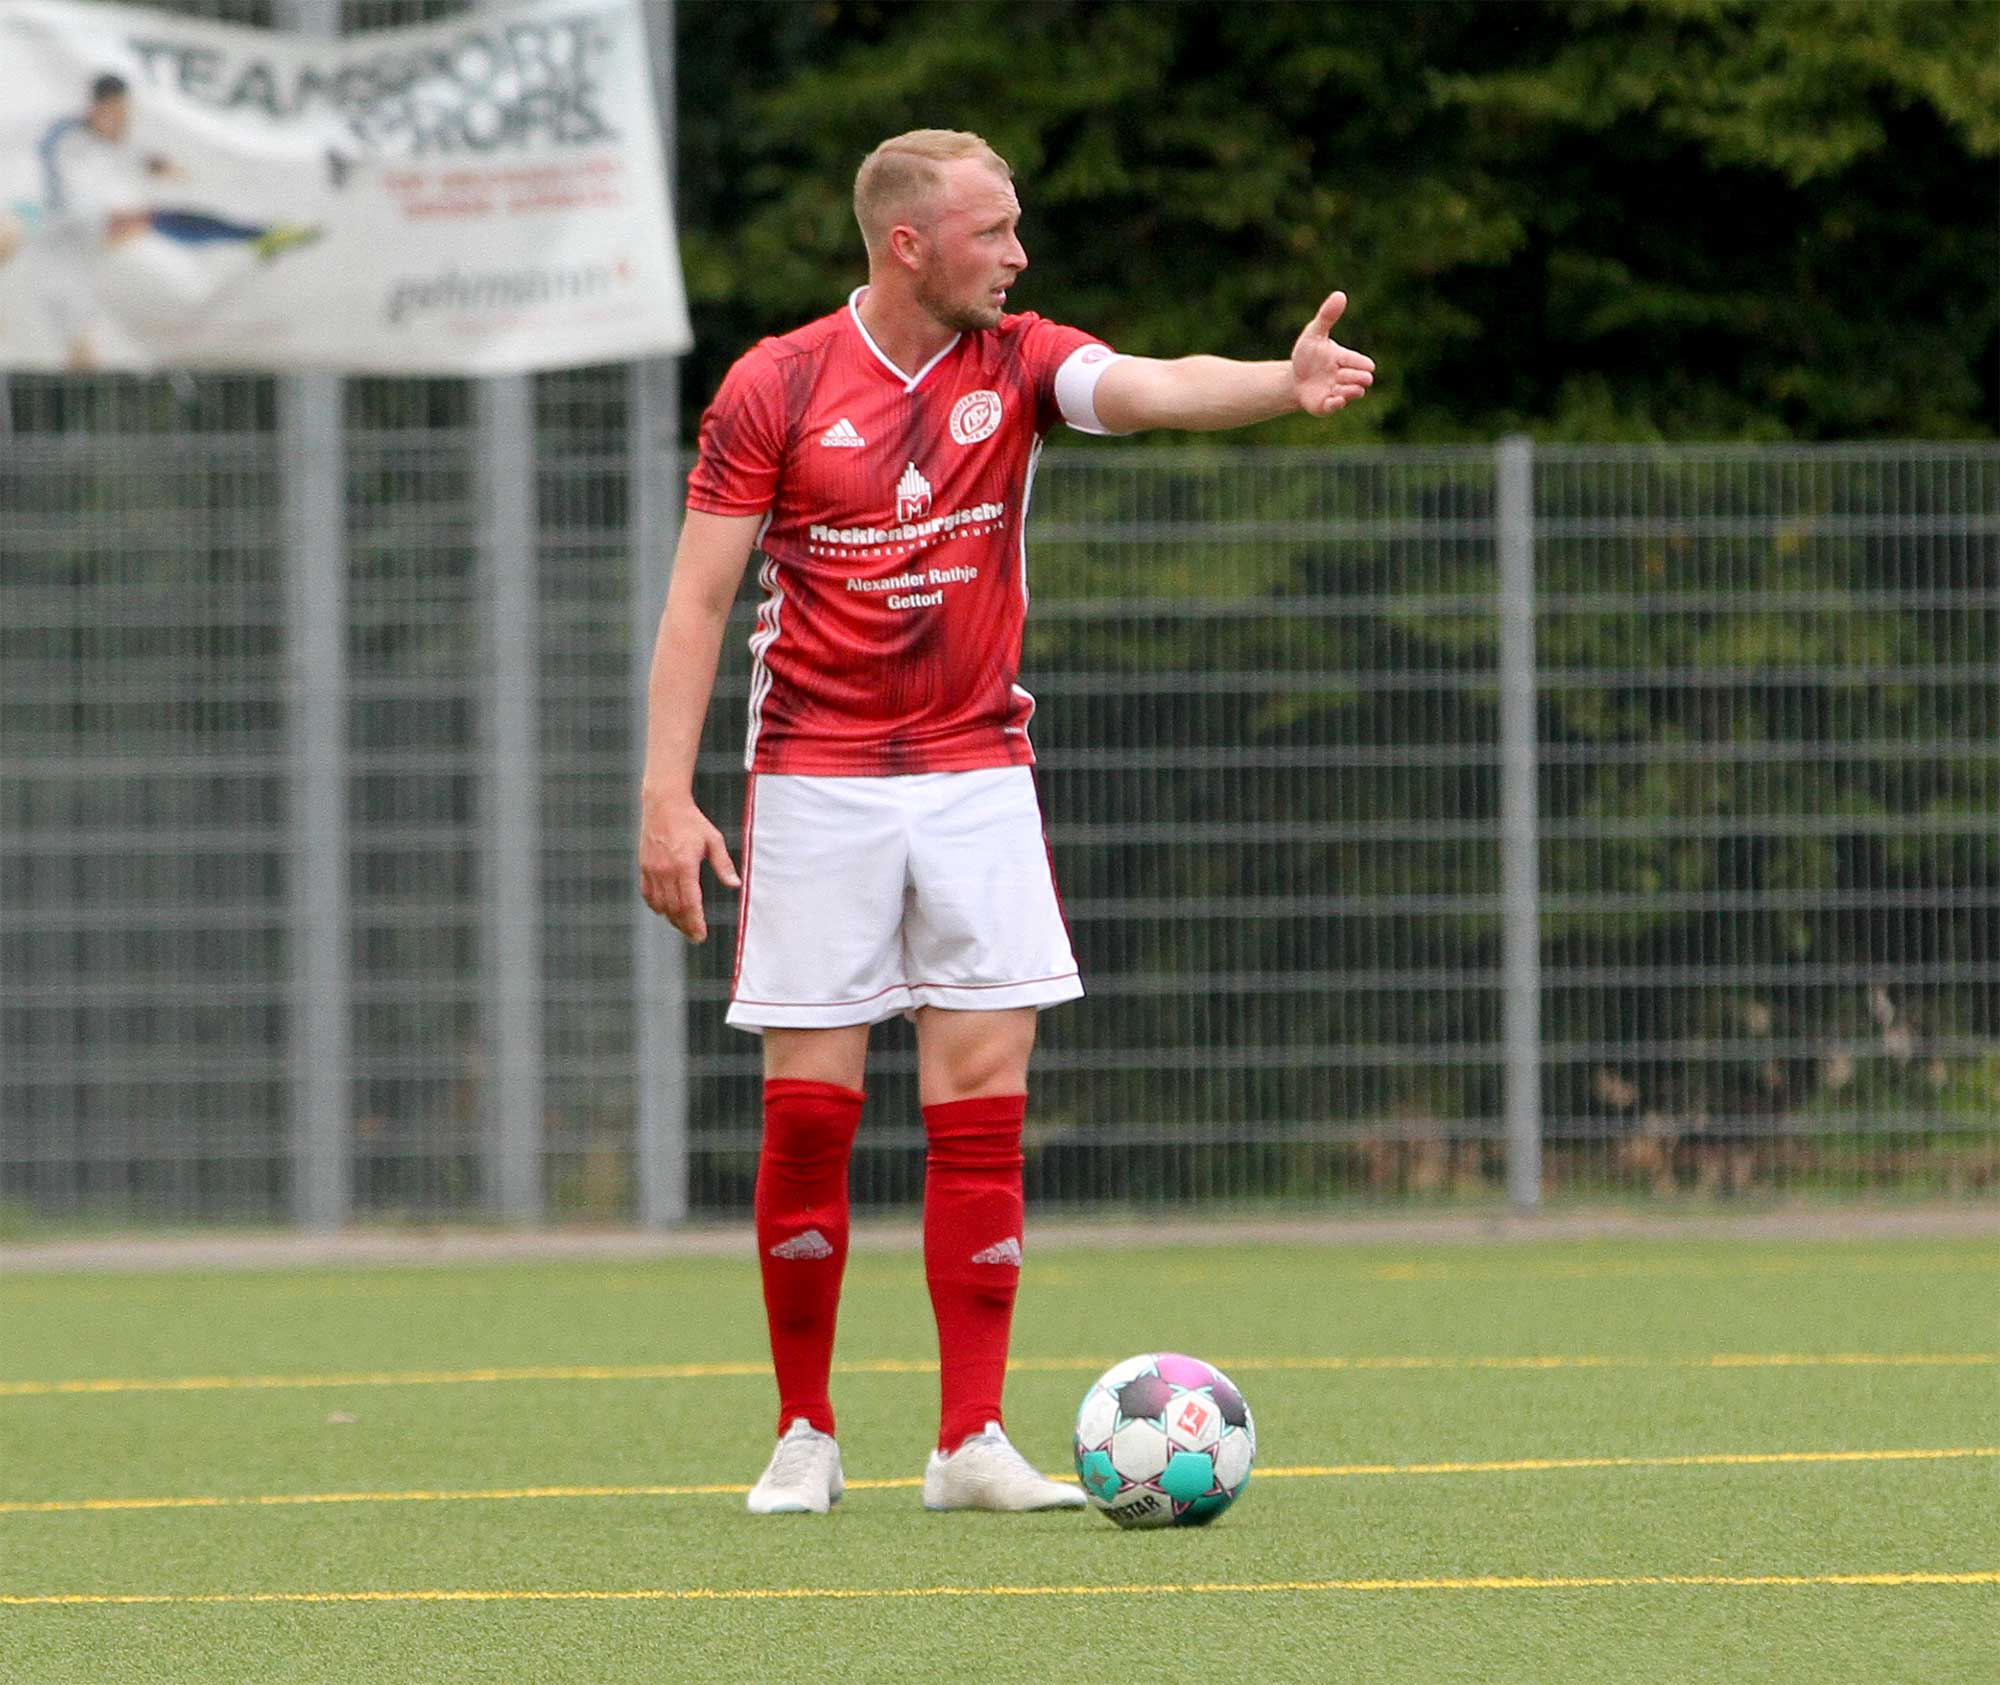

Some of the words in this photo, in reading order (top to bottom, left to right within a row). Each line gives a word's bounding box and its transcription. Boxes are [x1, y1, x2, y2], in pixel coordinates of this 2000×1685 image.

[809, 502, 1004, 544] Mecklenburgische
[846, 572, 926, 592] Alexander
[928, 565, 978, 585] Rathje
[887, 590, 944, 611] Gettorf
